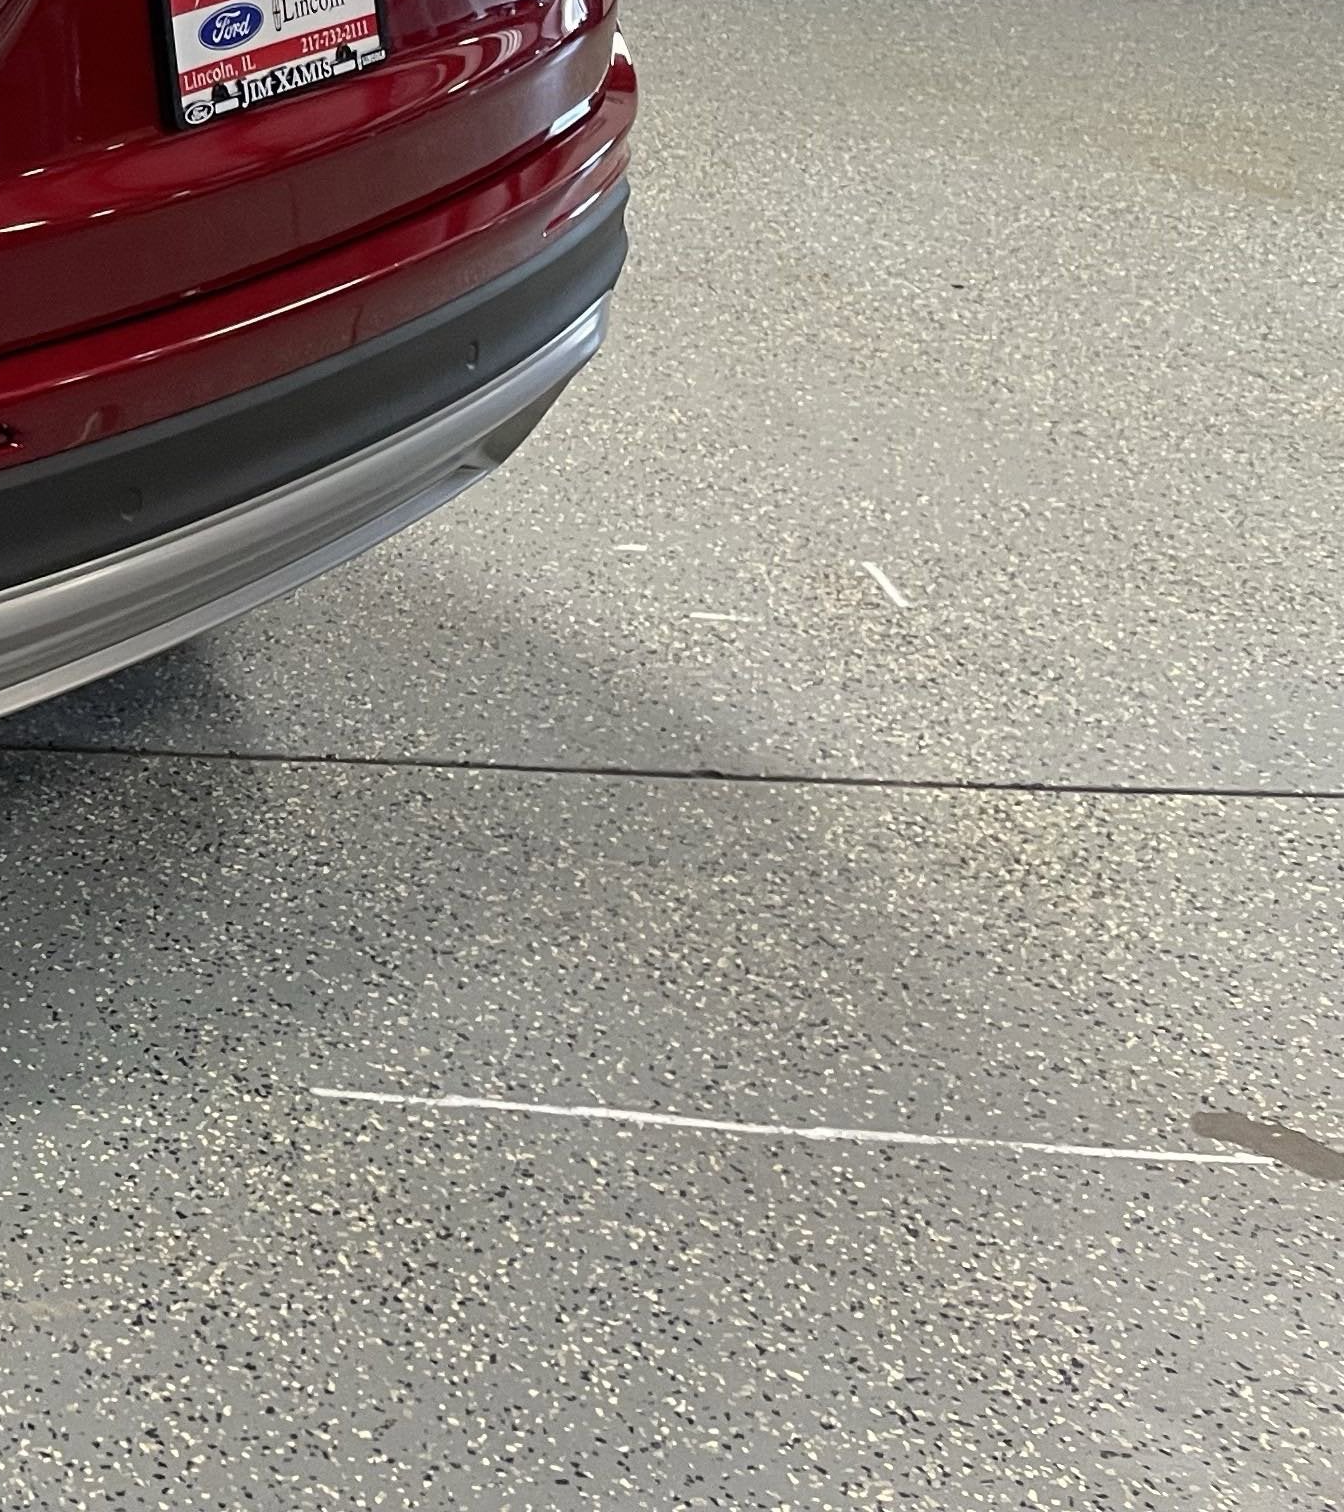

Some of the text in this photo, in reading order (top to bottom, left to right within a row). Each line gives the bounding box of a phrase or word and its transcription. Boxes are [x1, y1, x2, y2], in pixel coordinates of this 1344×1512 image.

[212, 10, 252, 44] Ford
[301, 20, 369, 53] 217-732-2111
[242, 54, 257, 70] IL
[241, 59, 333, 108] JIM XAMIS
